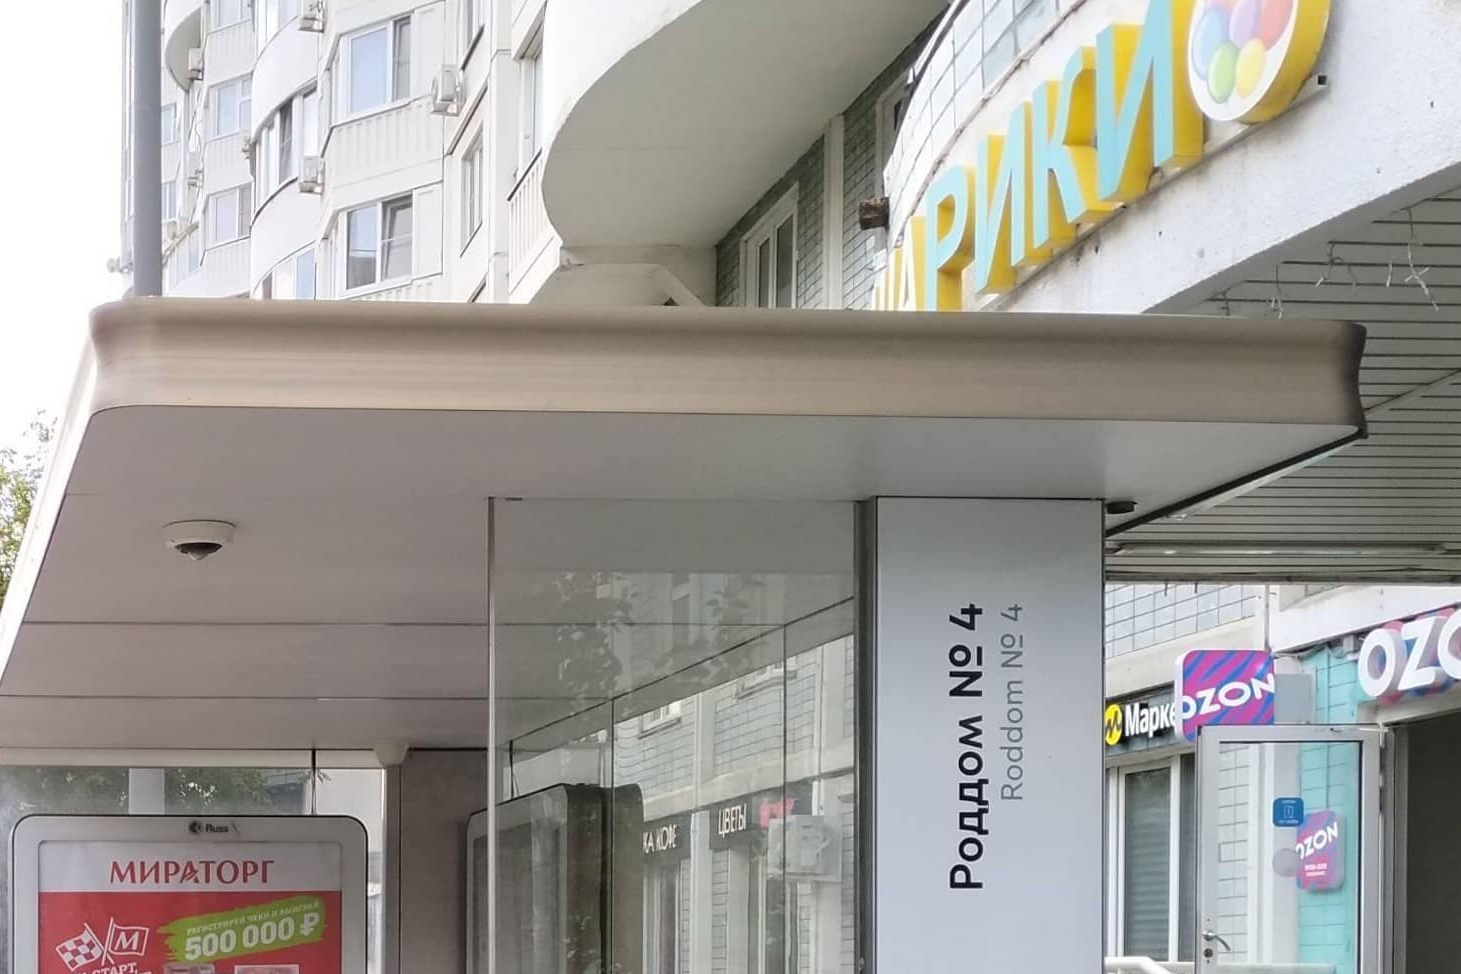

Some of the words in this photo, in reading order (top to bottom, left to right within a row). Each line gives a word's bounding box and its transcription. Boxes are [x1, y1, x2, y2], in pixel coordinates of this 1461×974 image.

[949, 603, 983, 631] 4
[1000, 604, 1023, 622] 4
[1000, 633, 1023, 668] №
[949, 644, 983, 697] №
[999, 680, 1023, 800] Roddom
[949, 715, 989, 889] Роддом
[718, 803, 747, 839] ЦВЕТЫ
[110, 860, 275, 884] МИРАТОРГ
[185, 929, 236, 960] 500
[242, 916, 295, 948] 000
